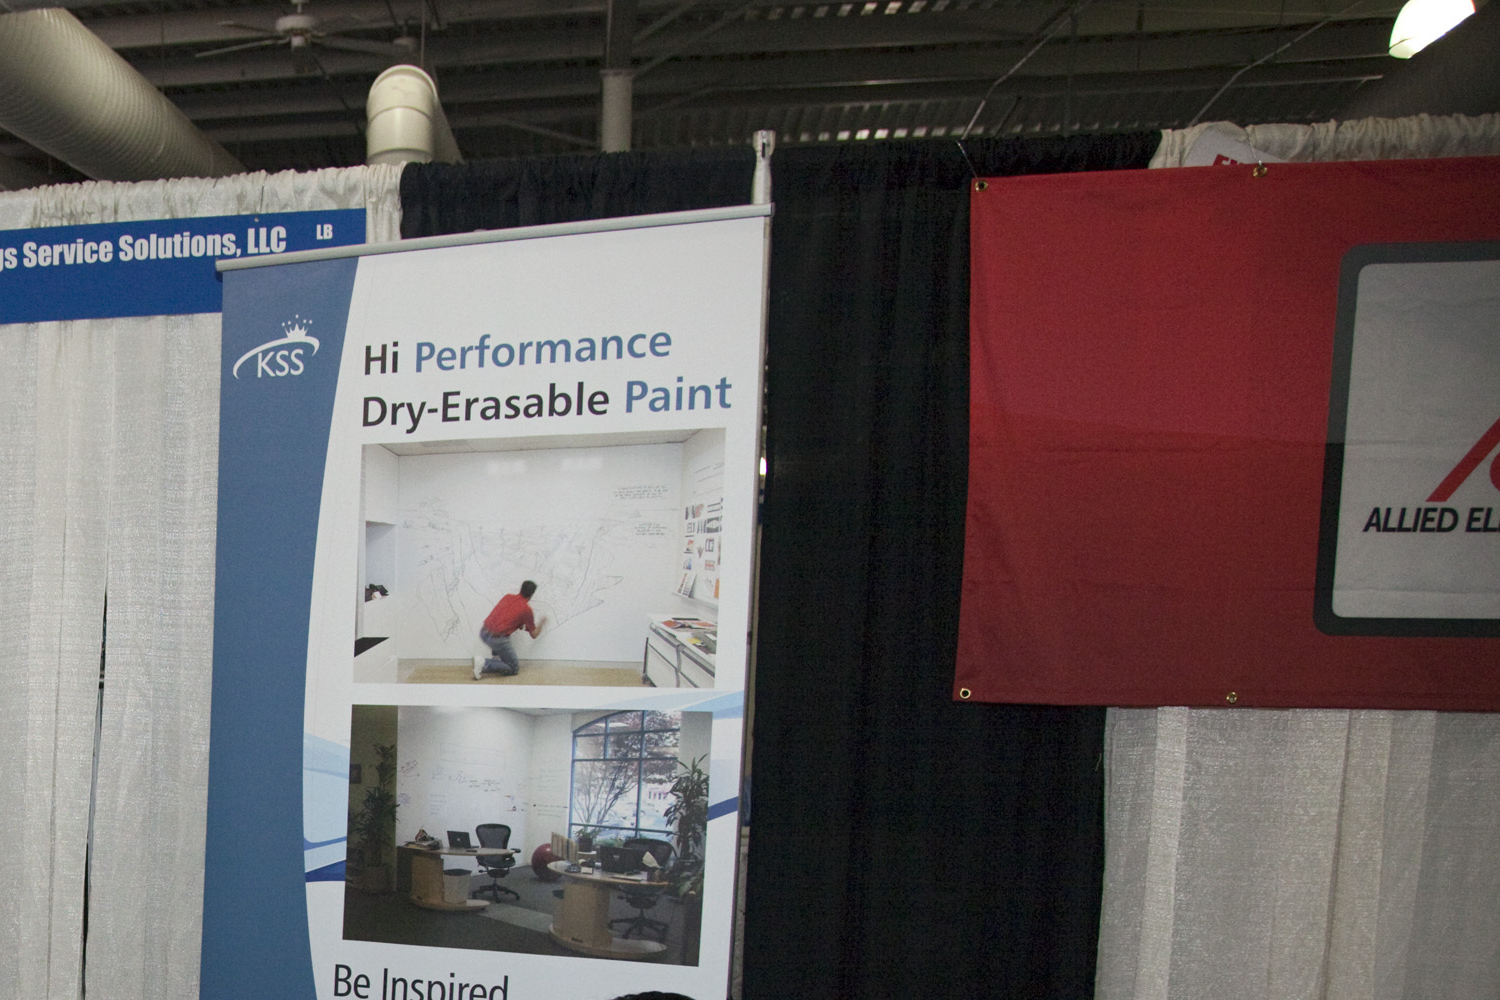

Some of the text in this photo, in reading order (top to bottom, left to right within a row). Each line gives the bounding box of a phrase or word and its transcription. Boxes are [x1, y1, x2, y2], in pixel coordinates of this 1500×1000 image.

[23, 236, 114, 268] Service
[119, 228, 242, 263] Solutions,
[247, 226, 287, 254] LLC
[316, 224, 334, 241] LB
[257, 348, 304, 378] KSS
[364, 331, 672, 375] Hi Performance
[361, 375, 732, 434] Dry-Erasable Paint
[1363, 507, 1500, 532] ALLIED EL
[333, 963, 371, 1000] Be
